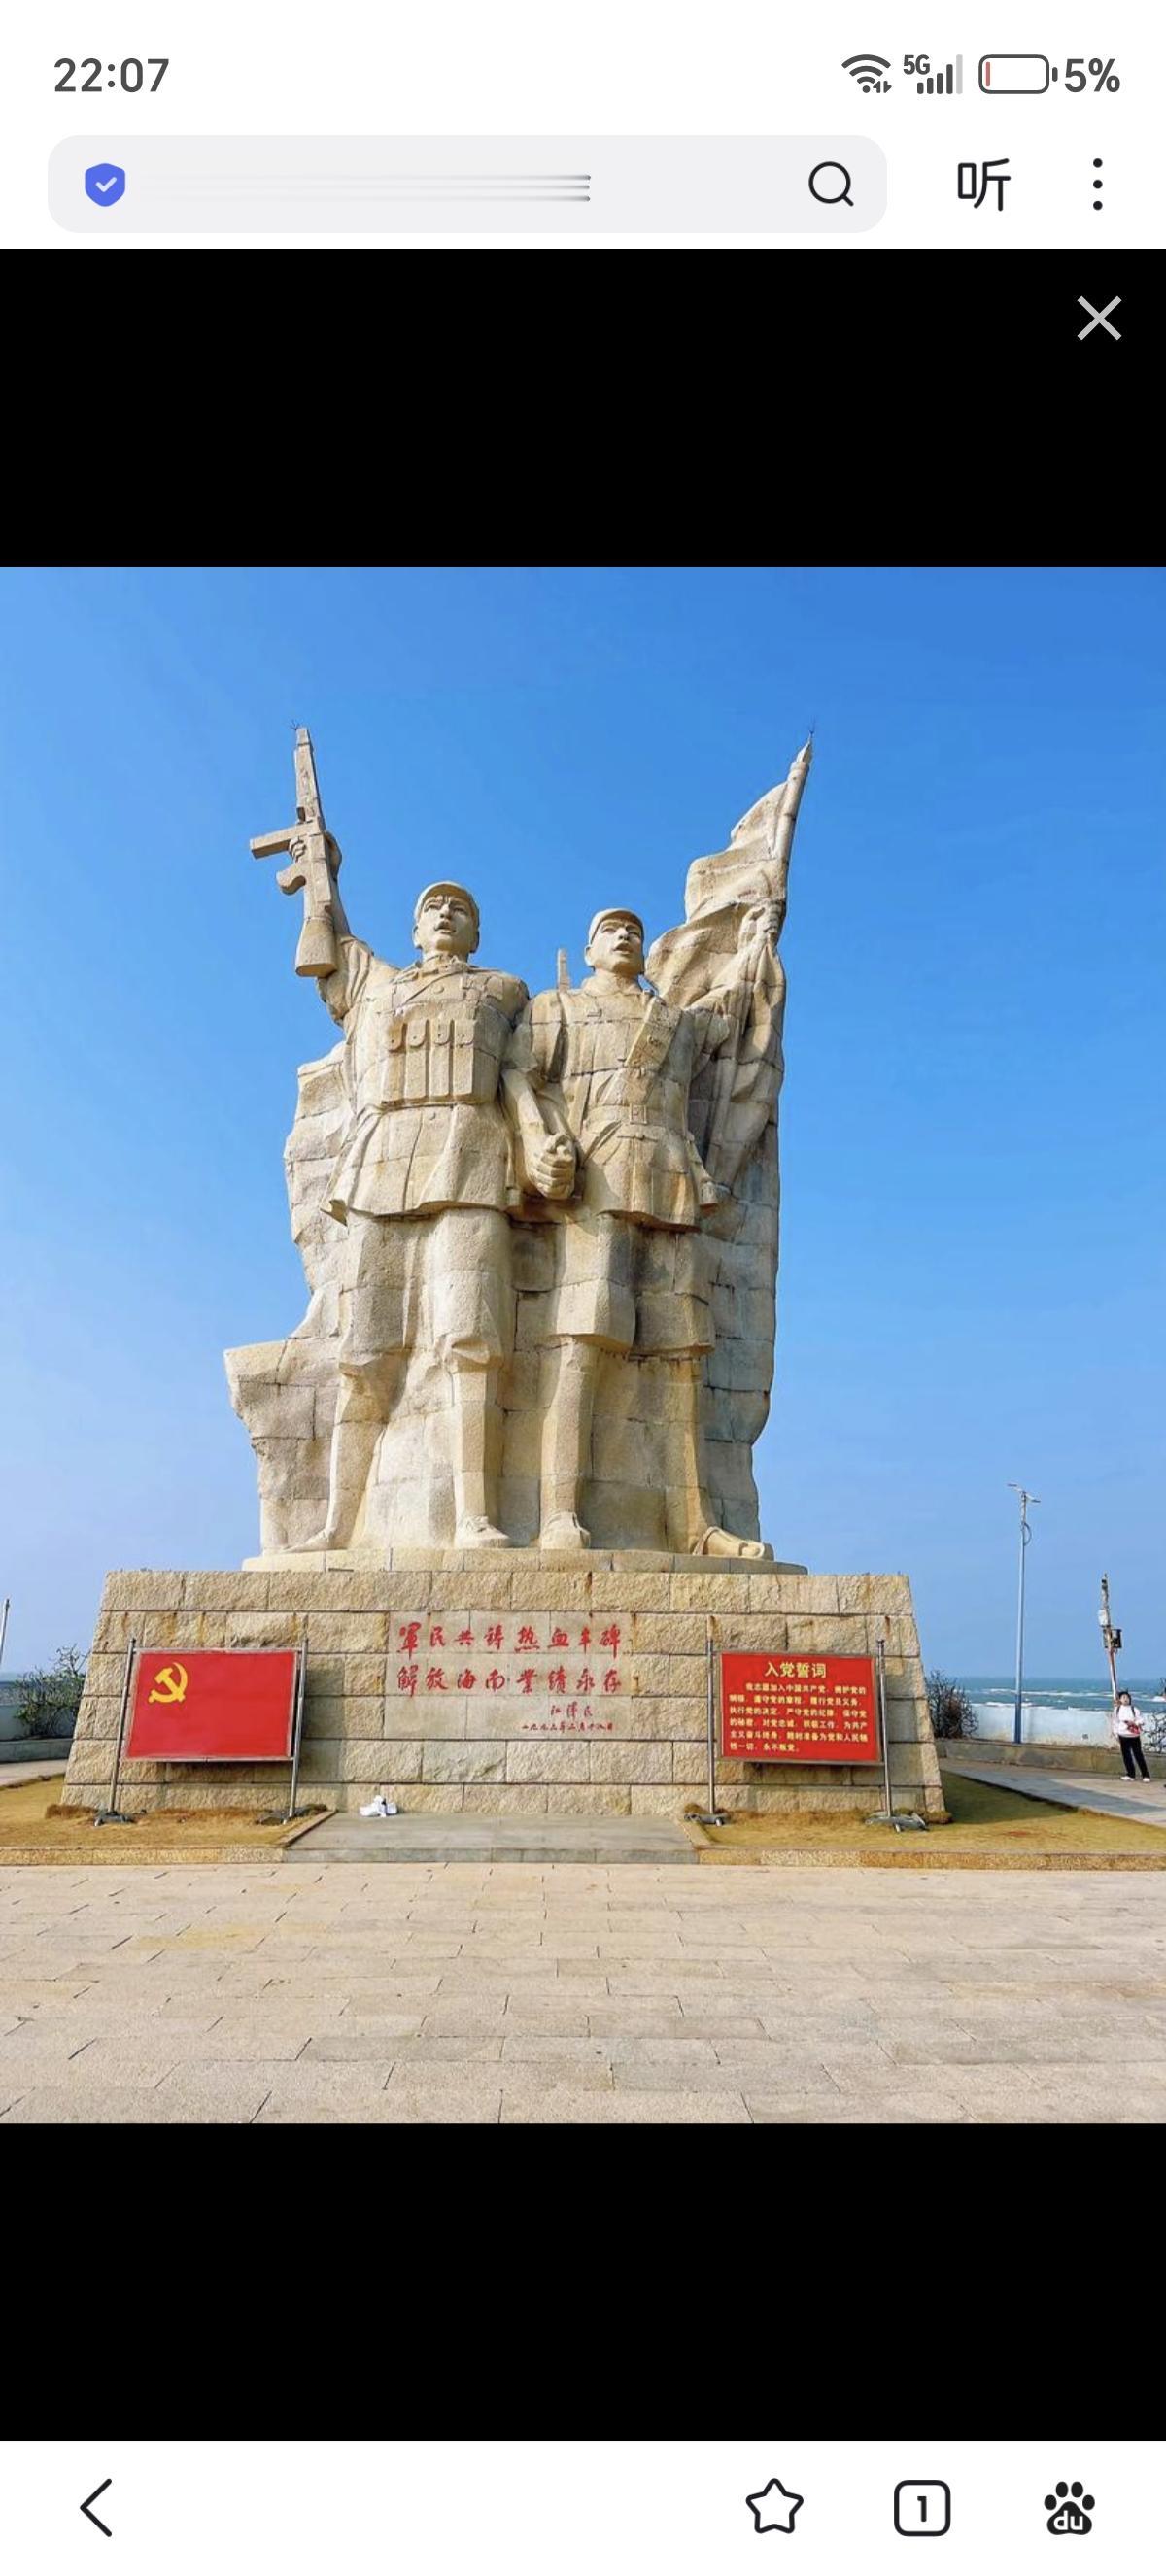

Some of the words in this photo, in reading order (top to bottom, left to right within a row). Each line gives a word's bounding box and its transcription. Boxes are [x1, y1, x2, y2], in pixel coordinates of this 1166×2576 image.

[54, 58, 168, 92] 22:07
[904, 54, 930, 75] 5G
[1065, 58, 1119, 92] 5%
[958, 158, 1011, 211] 听
[764, 1662, 827, 1679] 入党誓词
[916, 2495, 928, 2523] 1
[1052, 2510, 1083, 2530] du
